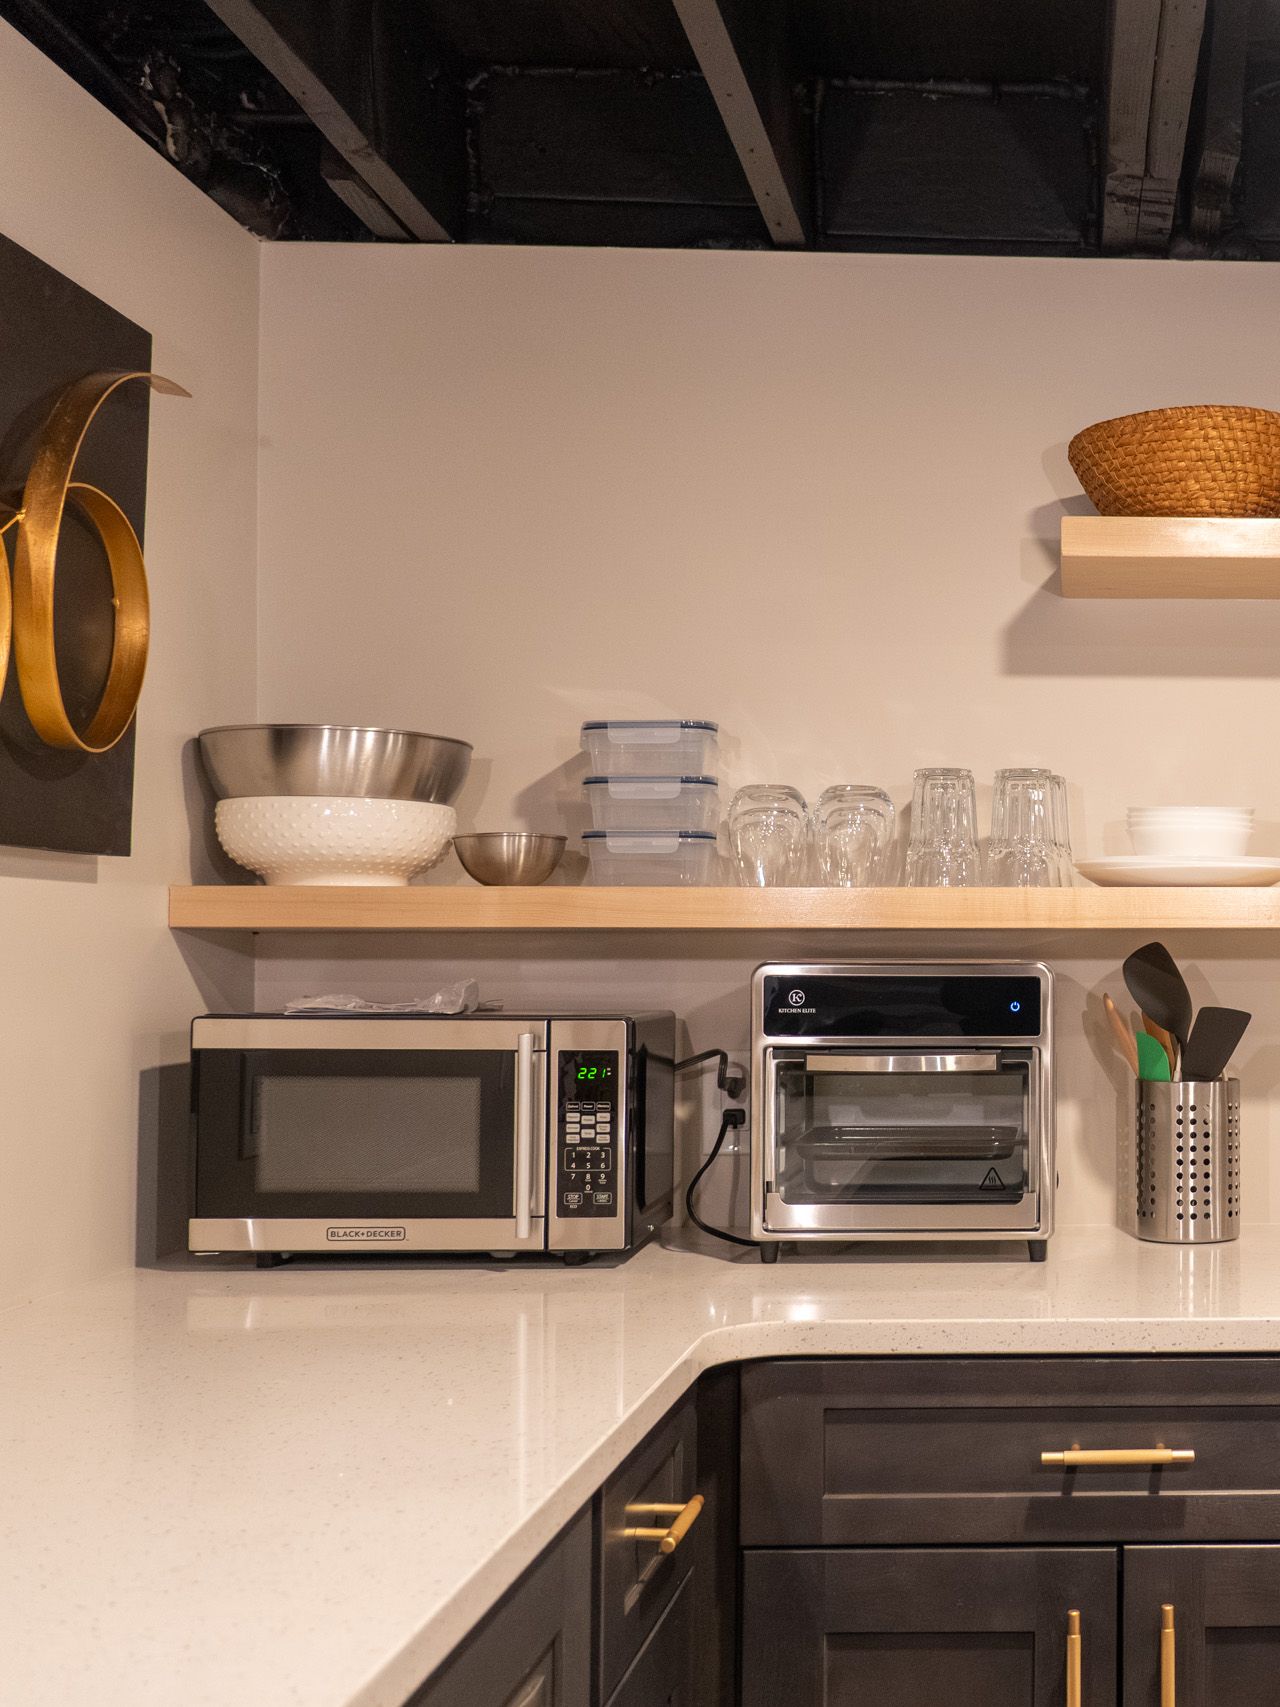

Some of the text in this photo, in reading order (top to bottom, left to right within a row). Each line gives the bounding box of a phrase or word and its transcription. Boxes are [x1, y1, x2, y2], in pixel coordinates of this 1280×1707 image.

[572, 1151, 606, 1159] 1 2 3
[330, 1230, 402, 1238] BLACK+DECKER
